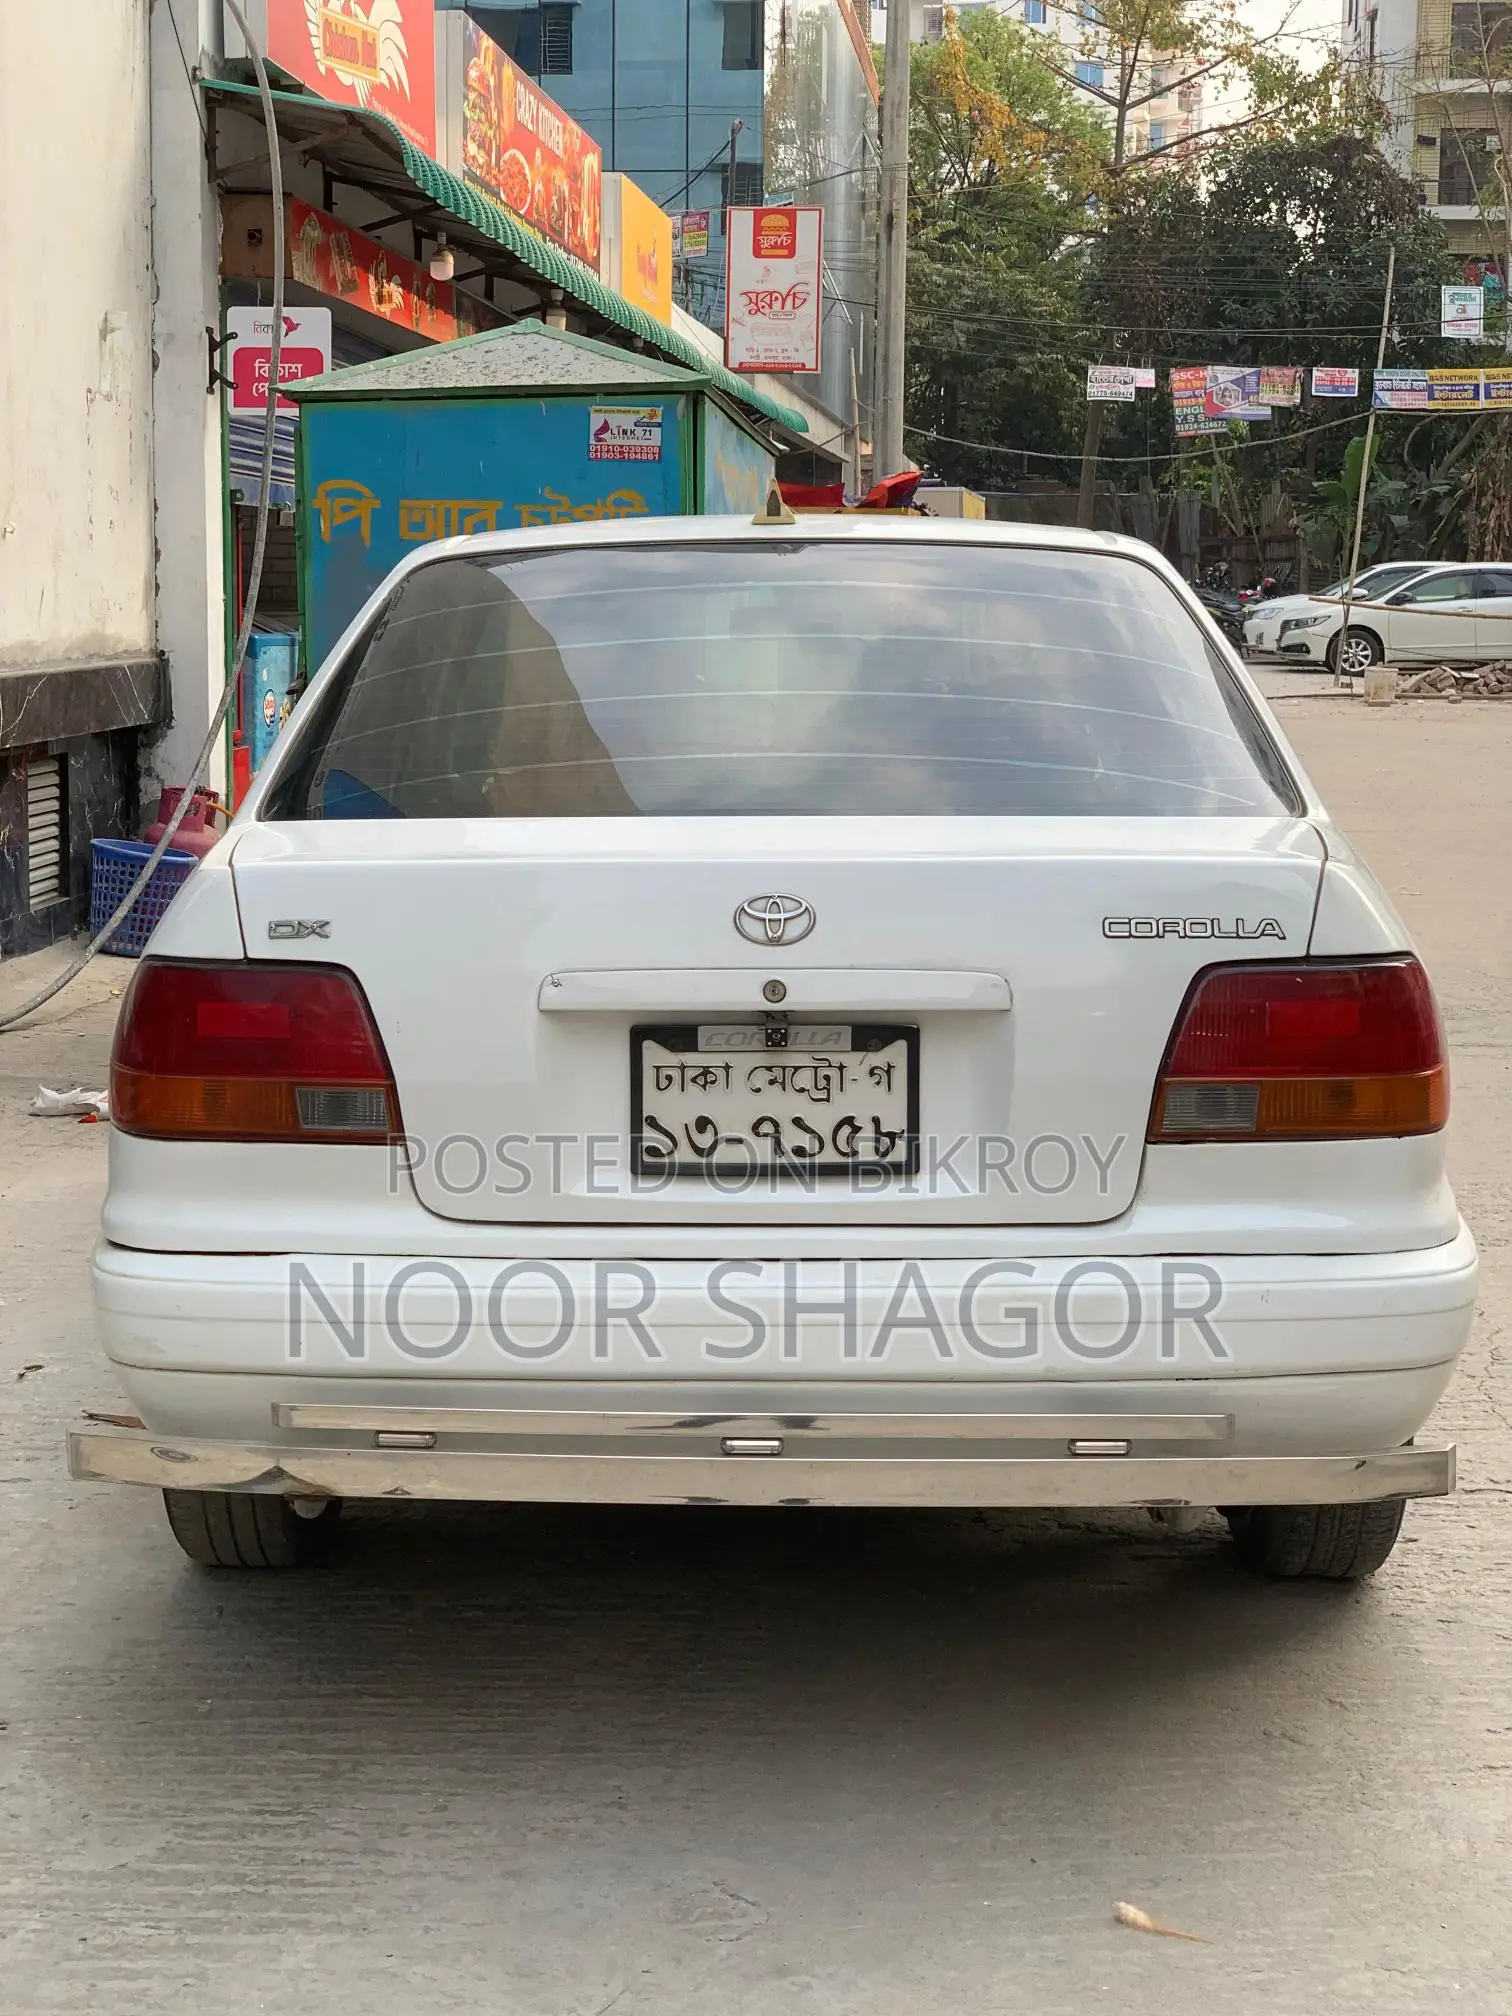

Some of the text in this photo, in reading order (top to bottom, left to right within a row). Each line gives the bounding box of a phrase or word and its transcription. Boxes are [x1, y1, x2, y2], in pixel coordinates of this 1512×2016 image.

[516, 80, 564, 158] CRAZY KITCHEN
[739, 281, 811, 317] সুরুচি
[610, 427, 636, 436] LINK
[268, 920, 331, 939] DX
[1103, 917, 1286, 940] COROLLA
[704, 1031, 842, 1047] CORLLA
[652, 1061, 733, 1092] ঢাকা
[644, 1115, 905, 1158] ১৩-৭১৫৮
